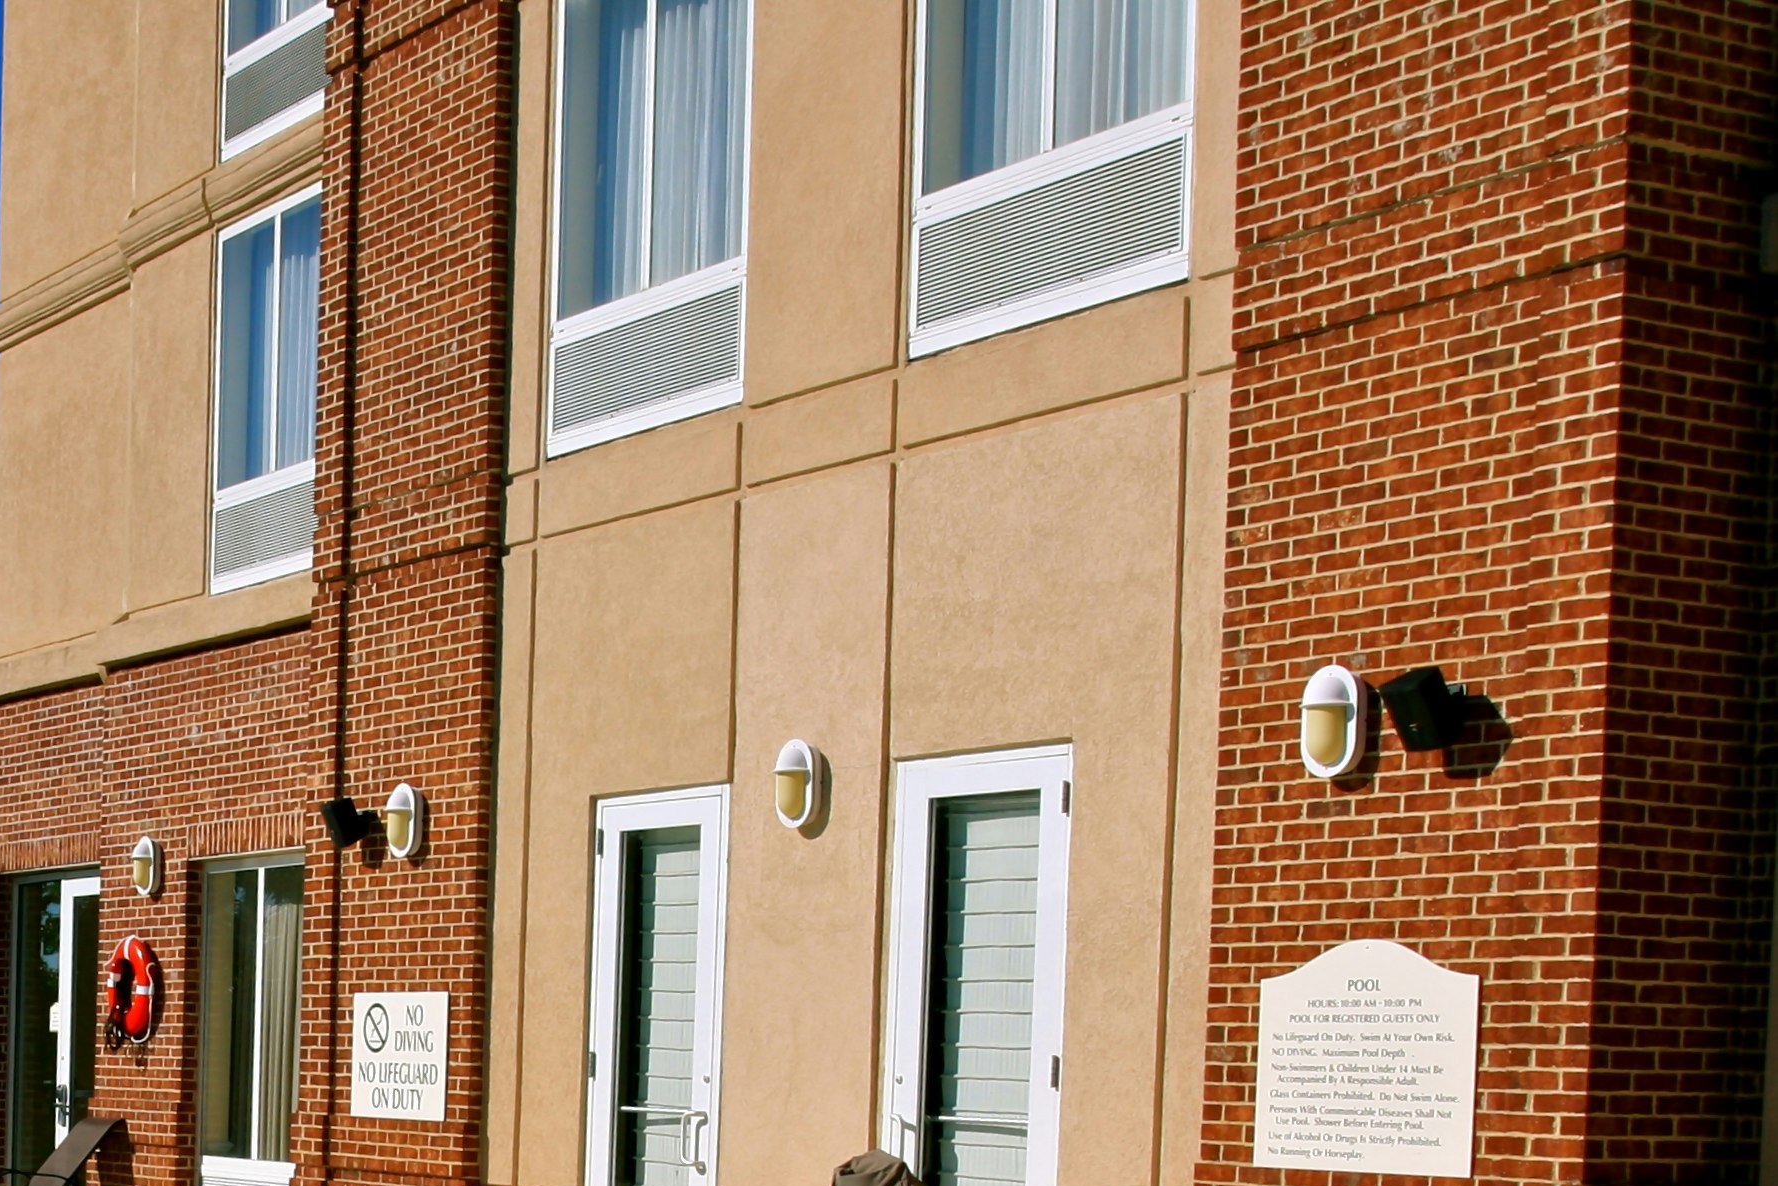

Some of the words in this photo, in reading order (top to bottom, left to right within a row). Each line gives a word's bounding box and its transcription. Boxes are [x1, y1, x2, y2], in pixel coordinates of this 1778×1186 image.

[1347, 979, 1381, 992] POOL
[1307, 999, 1339, 1008] HOURS:
[1341, 999, 1362, 1008] 10:00
[1364, 999, 1377, 1007] AM
[1384, 999, 1406, 1007] 10:00
[1408, 998, 1422, 1007] PM
[406, 1004, 424, 1027] NO
[1289, 1014, 1311, 1023] POOL
[1313, 1014, 1330, 1023] FOR
[1332, 1014, 1380, 1023] REGISTERED
[1382, 1014, 1414, 1023] GUESTS
[1416, 1014, 1440, 1023] ONLY
[394, 1030, 434, 1053] DIVING
[1272, 1033, 1283, 1041] No
[1285, 1032, 1319, 1043] Lifeguard
[1321, 1033, 1333, 1041] On
[1335, 1033, 1356, 1043] Duty.
[1360, 1032, 1381, 1041] Swim
[1383, 1033, 1391, 1041] At
[1394, 1033, 1412, 1041] Your
[1414, 1033, 1434, 1041] Own
[1435, 1032, 1455, 1042] Risk.
[1272, 1048, 1285, 1056] NO
[1323, 1048, 1360, 1057] Maximum
[1362, 1048, 1379, 1057] Pool
[1381, 1048, 1405, 1060] Depth
[358, 1061, 376, 1083] NO
[379, 1062, 438, 1085] LIFEGUARD
[1329, 1064, 1334, 1072] &
[1337, 1064, 1369, 1073] Children
[1372, 1064, 1396, 1073] Under
[1400, 1065, 1408, 1073] 14
[1411, 1065, 1431, 1074] Must
[1433, 1065, 1444, 1074] Be
[1278, 1075, 1327, 1086] Accompanied
[1329, 1075, 1337, 1086] By
[1339, 1076, 1345, 1084] A
[1348, 1076, 1394, 1086] Responsible
[372, 1087, 389, 1109] ON
[392, 1088, 423, 1111] DUTY
[1270, 1089, 1289, 1098] Glass
[1292, 1090, 1331, 1099] Containers
[1380, 1092, 1391, 1101] Do
[1394, 1093, 1408, 1101] Not
[1410, 1093, 1432, 1102] Swim
[1434, 1093, 1460, 1103] Alone.
[1269, 1105, 1297, 1113] Persons
[1299, 1105, 1317, 1114] With
[1319, 1106, 1376, 1116] Communicable
[1379, 1108, 1412, 1117] Diseases
[1415, 1109, 1434, 1118] Shall
[1437, 1110, 1451, 1118] Not
[1276, 1116, 1290, 1125] Use
[1292, 1117, 1310, 1125] Pool.
[1314, 1117, 1342, 1126] Shower
[1343, 1119, 1368, 1128] Before
[1370, 1120, 1402, 1132] Entering
[1404, 1121, 1424, 1130] Pool.
[1268, 1132, 1282, 1140] Use
[1284, 1132, 1292, 1140] of
[1294, 1132, 1321, 1141] Alcohol
[1323, 1133, 1333, 1142] Or
[1335, 1134, 1358, 1145] Drugs
[1360, 1135, 1366, 1143] Is
[1368, 1135, 1396, 1147] Strictly
[1397, 1136, 1441, 1147] Prohibited.
[1268, 1147, 1279, 1155] No
[1280, 1147, 1311, 1159] Running
[1312, 1148, 1323, 1157] Or
[1325, 1149, 1365, 1161] Horseplay.
